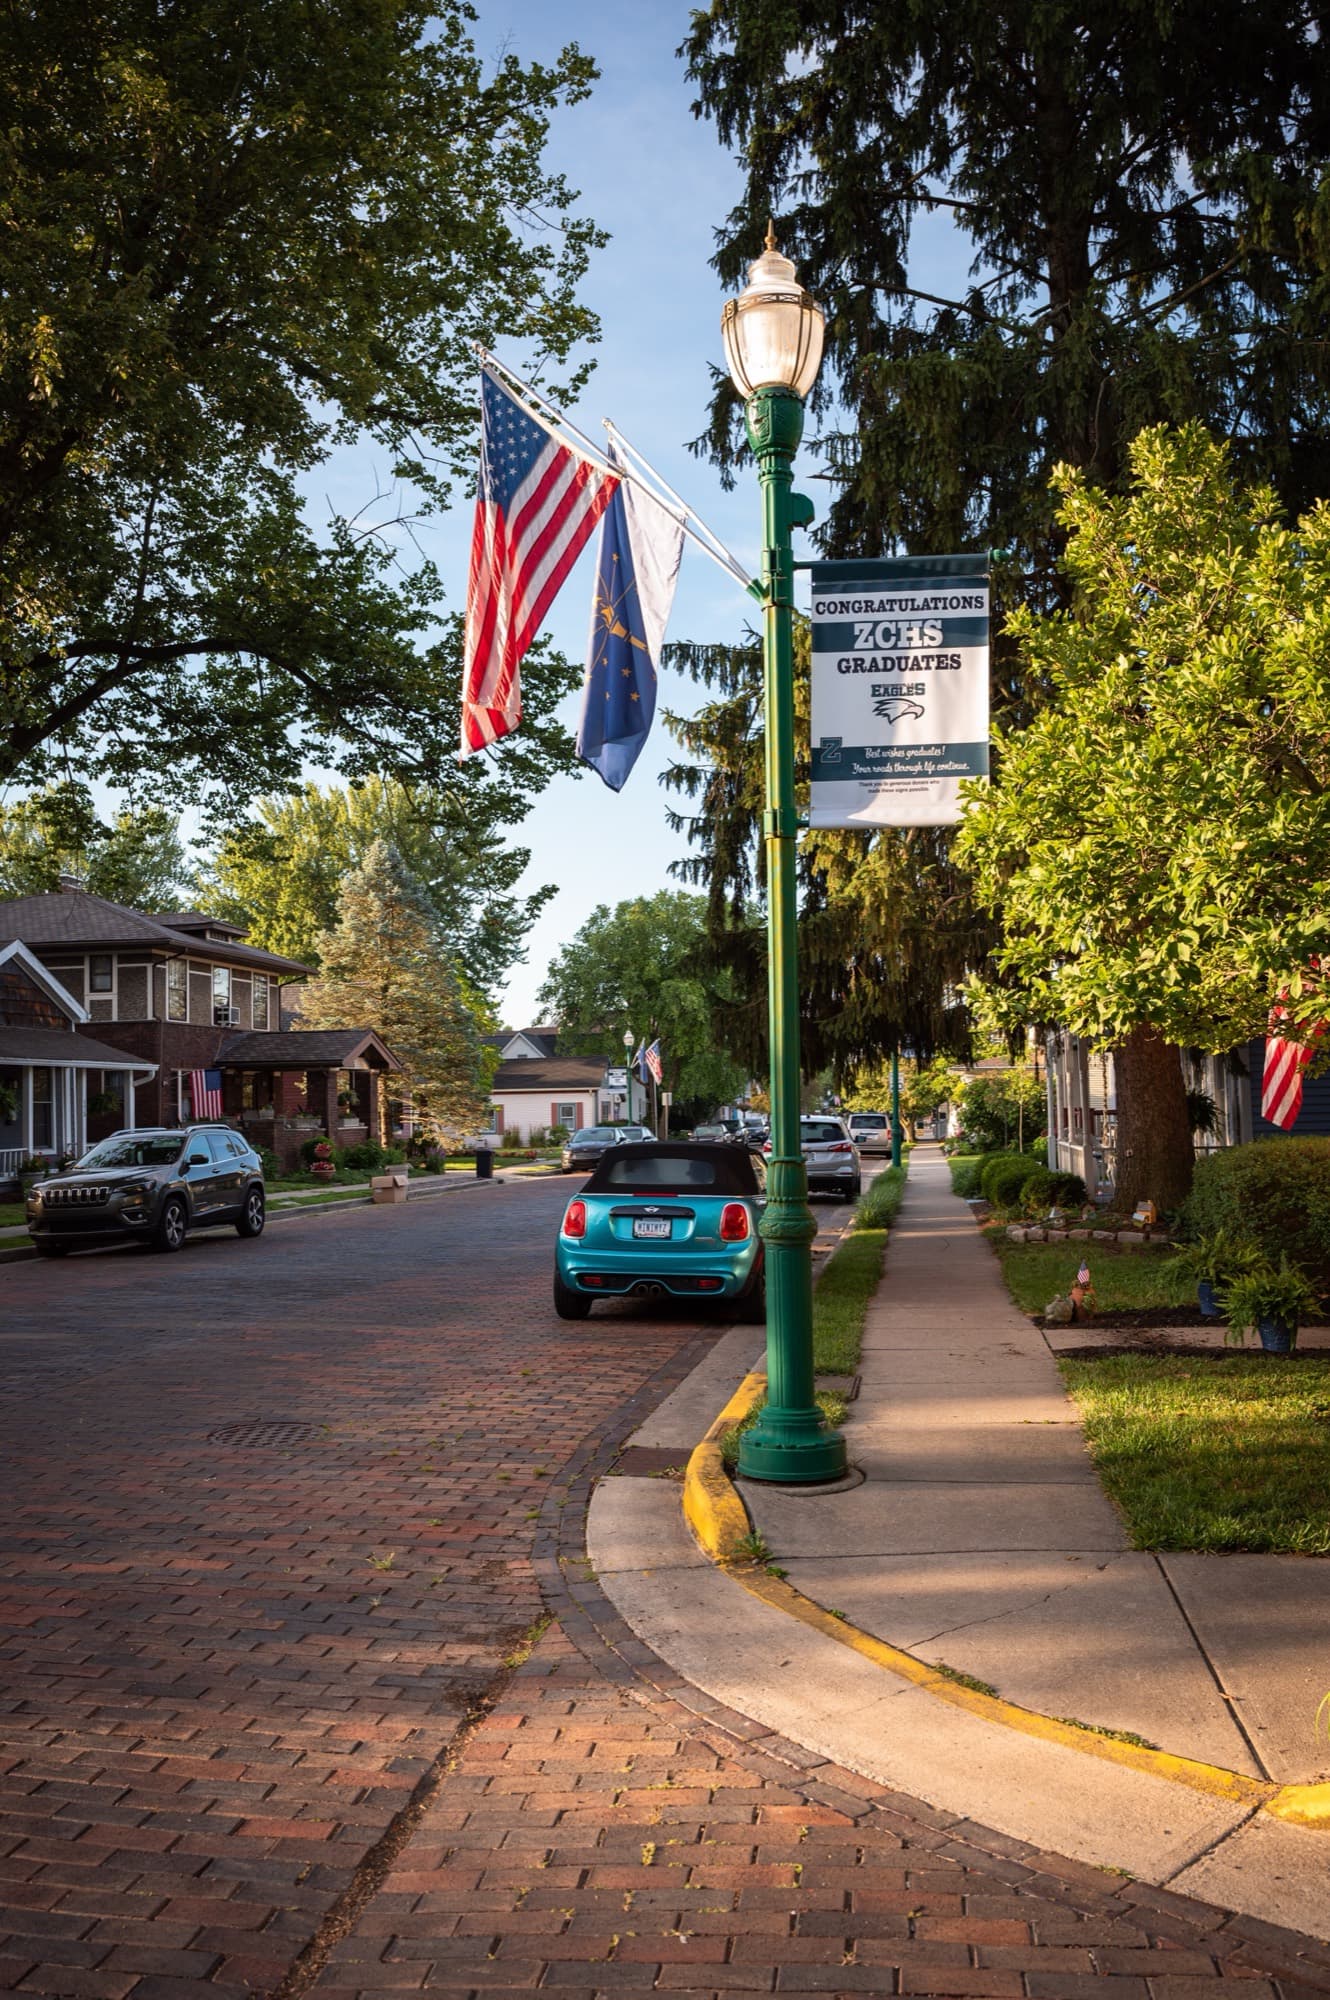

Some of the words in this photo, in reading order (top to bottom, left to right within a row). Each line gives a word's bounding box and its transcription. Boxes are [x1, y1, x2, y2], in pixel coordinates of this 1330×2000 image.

[815, 596, 984, 615] CONGRATULATIONS
[854, 620, 943, 649] ZCHS
[837, 654, 961, 674] GRADUATES
[871, 683, 925, 697] EAGLES
[820, 737, 842, 762] Z
[864, 748, 880, 758] Best
[881, 747, 905, 758] wishes
[906, 745, 945, 760] graduates!
[852, 763, 871, 774] Your
[872, 762, 893, 773] roads
[894, 762, 922, 774] through
[924, 761, 935, 774] life
[937, 760, 970, 770] continue.
